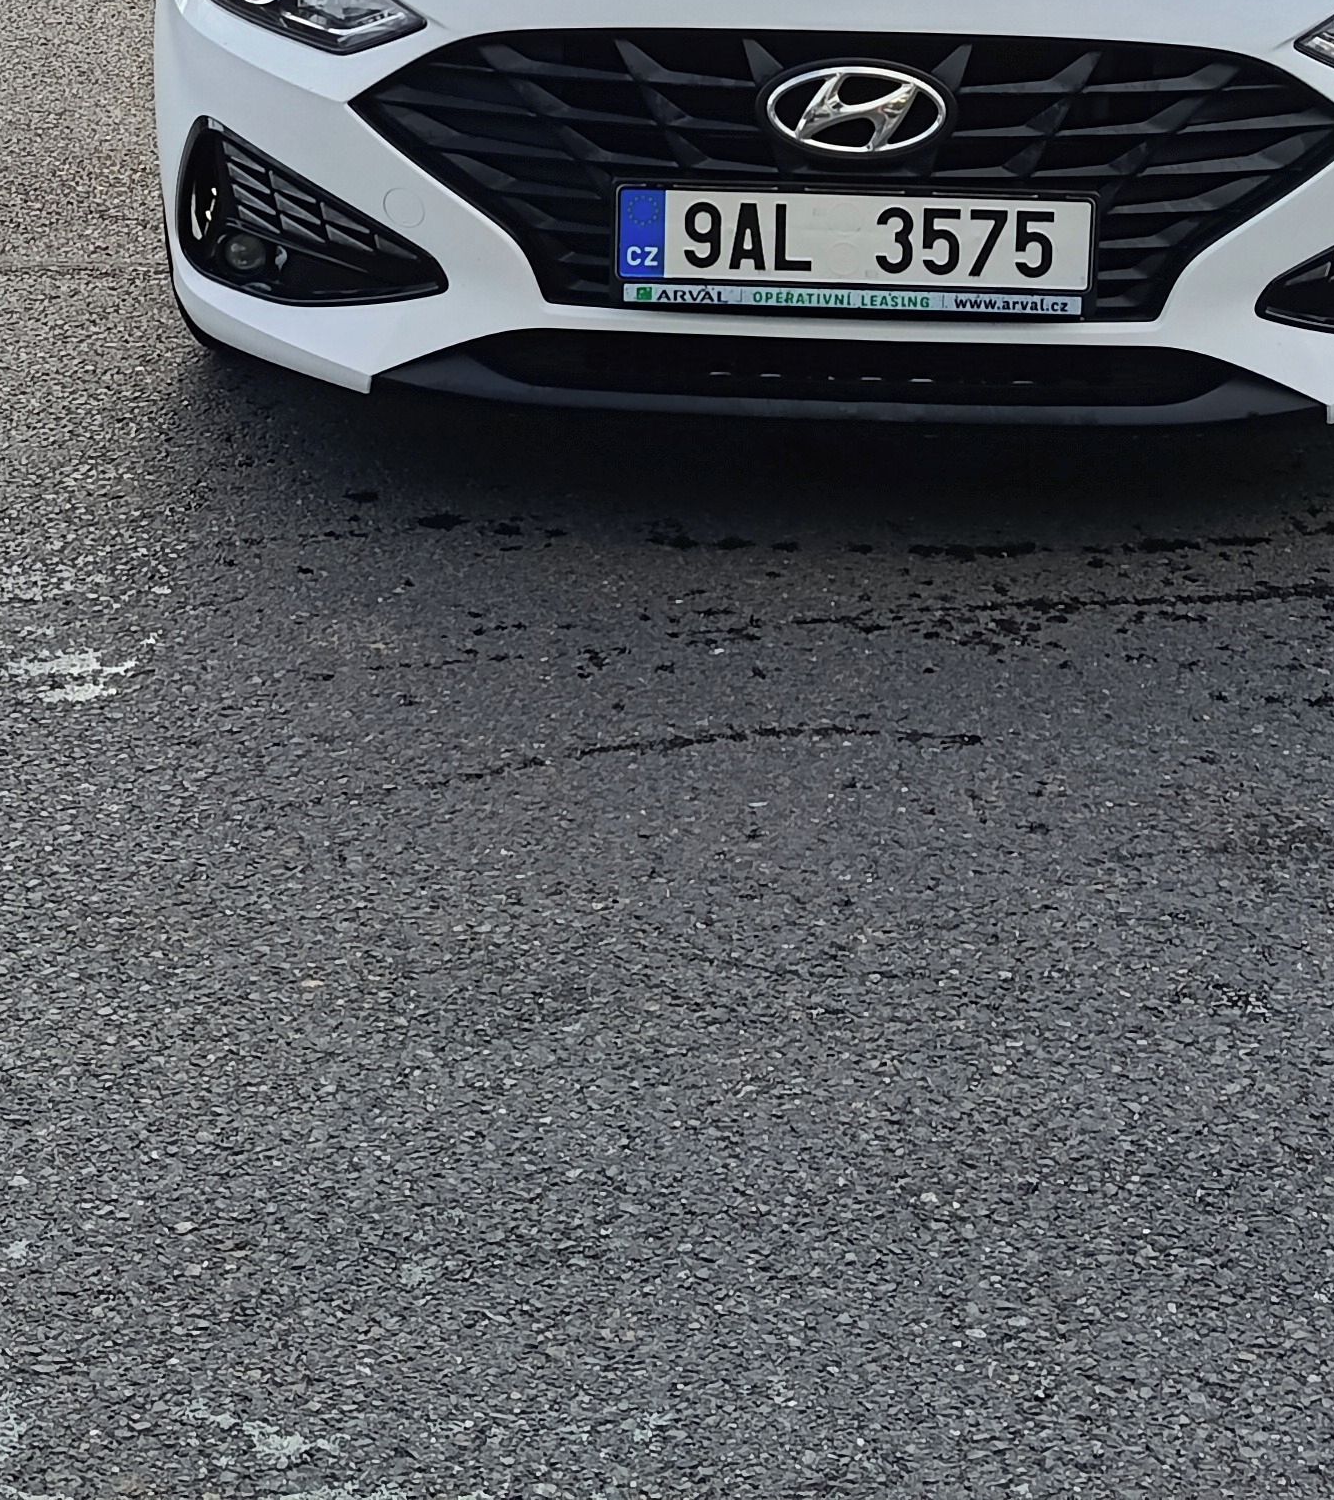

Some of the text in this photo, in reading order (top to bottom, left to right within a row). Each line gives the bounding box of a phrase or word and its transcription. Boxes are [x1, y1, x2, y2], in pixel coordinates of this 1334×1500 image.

[683, 201, 1056, 279] 9AL 3575
[625, 245, 659, 267] CZ
[656, 289, 729, 305] ARVAL
[860, 294, 931, 309] LEASING
[953, 296, 1070, 314] www.arval.cz
